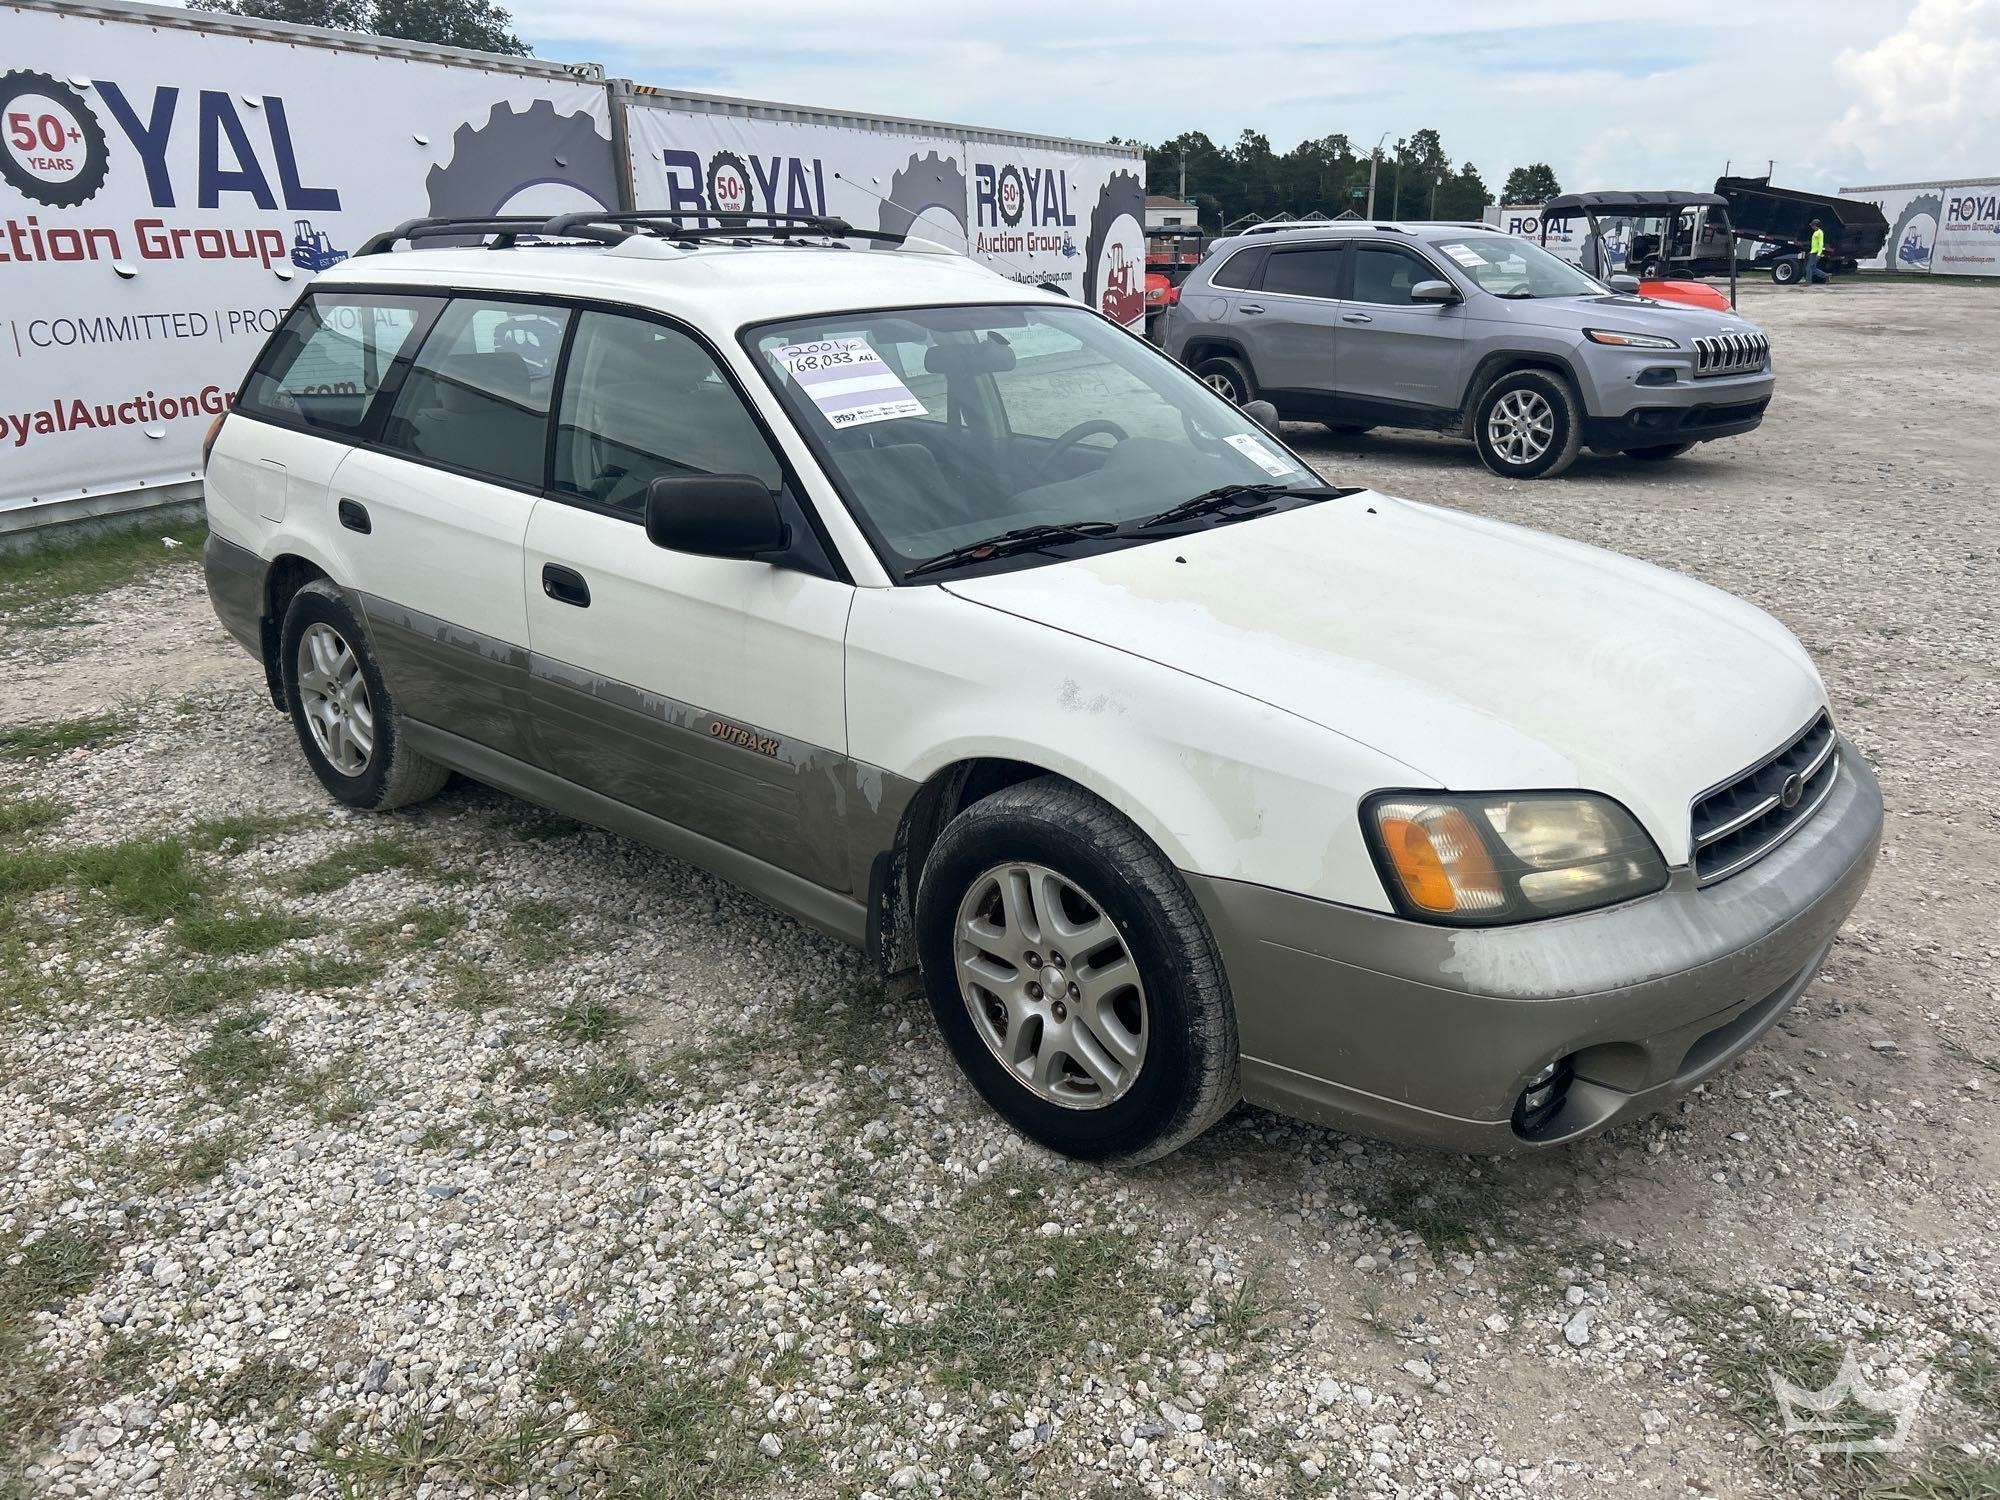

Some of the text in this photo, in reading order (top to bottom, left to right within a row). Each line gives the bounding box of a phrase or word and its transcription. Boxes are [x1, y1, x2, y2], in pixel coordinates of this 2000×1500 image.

[8, 112, 82, 153] 50+
[27, 156, 74, 171] YEARS
[717, 176, 744, 200] 50+
[975, 163, 1076, 228] ROYAL
[1004, 184, 1020, 202] 50+
[723, 203, 741, 211] YEARS
[1947, 196, 2000, 222] ROYA
[1509, 217, 1573, 235] ROAL
[0, 215, 286, 269] tion Group
[977, 231, 1062, 256] Auction Group
[1000, 270, 1072, 286] alAuctionGroup.com
[28, 312, 208, 347] COMMITTED
[789, 352, 853, 373] 168,033
[710, 720, 780, 757] OUTBACK
